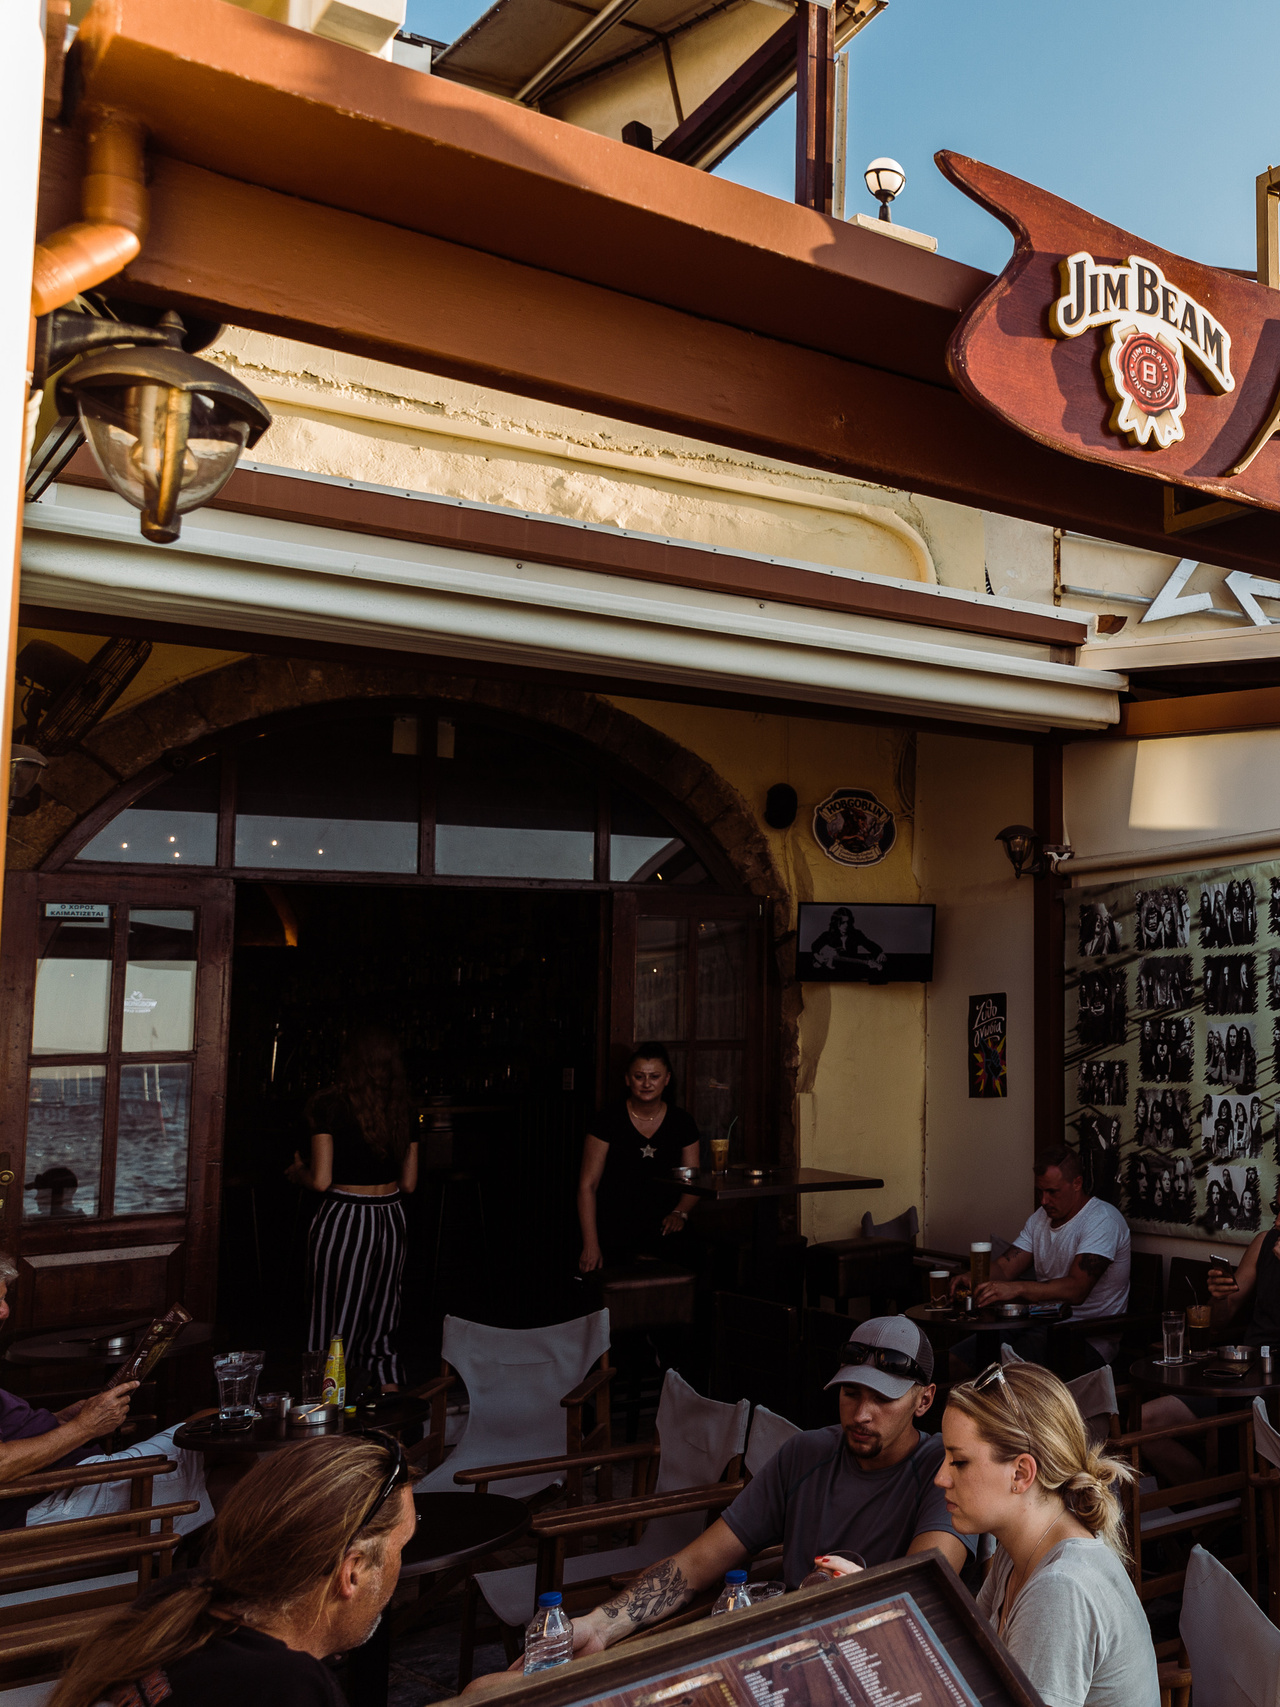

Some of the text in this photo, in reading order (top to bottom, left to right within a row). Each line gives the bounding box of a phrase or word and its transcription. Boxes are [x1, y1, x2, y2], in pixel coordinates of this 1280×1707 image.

[1063, 260, 1225, 372] JIM BEAM
[1131, 346, 1169, 373] JIM BEAM
[1130, 370, 1169, 399] SINCE 1795
[826, 798, 885, 817] HOBGOBLIN
